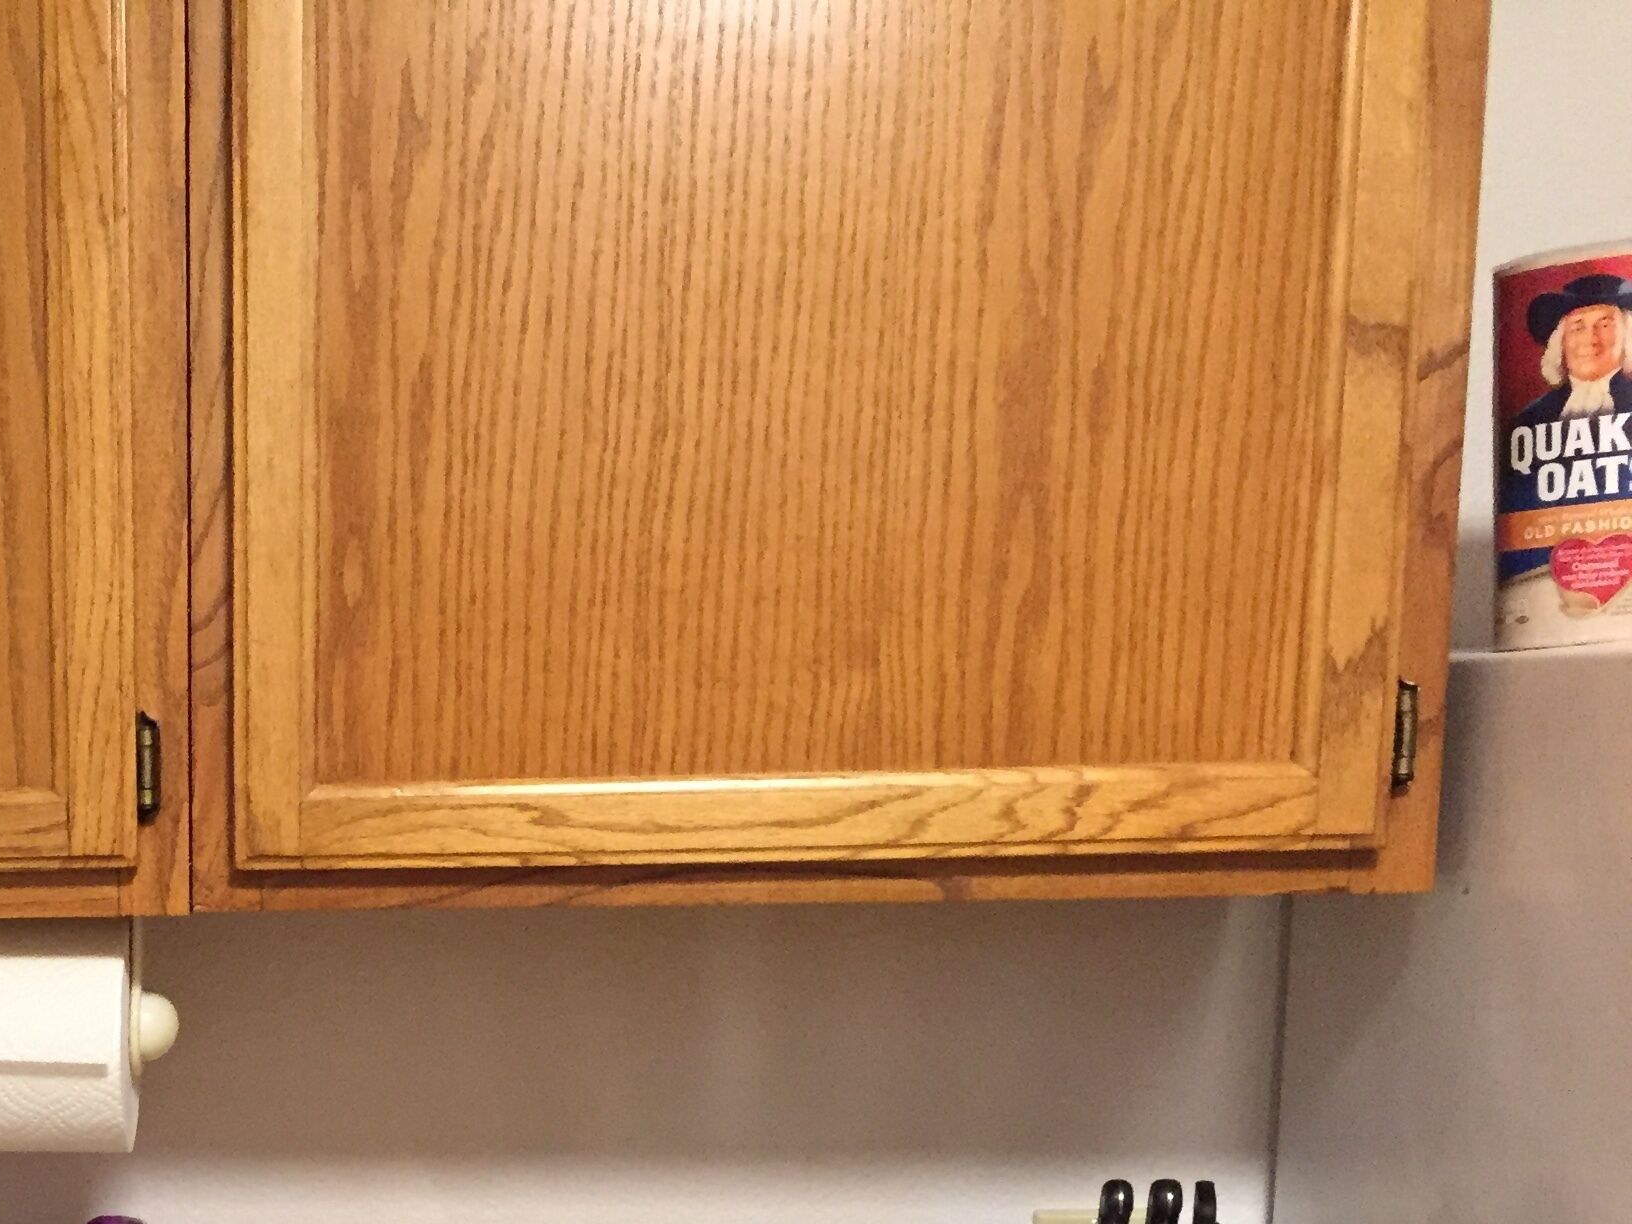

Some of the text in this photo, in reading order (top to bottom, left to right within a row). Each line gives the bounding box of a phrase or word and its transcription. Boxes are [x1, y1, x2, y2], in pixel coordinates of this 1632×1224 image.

[1510, 412, 1632, 474] QUAK
[1537, 455, 1632, 501] OAT
[1524, 525, 1554, 539] OLD
